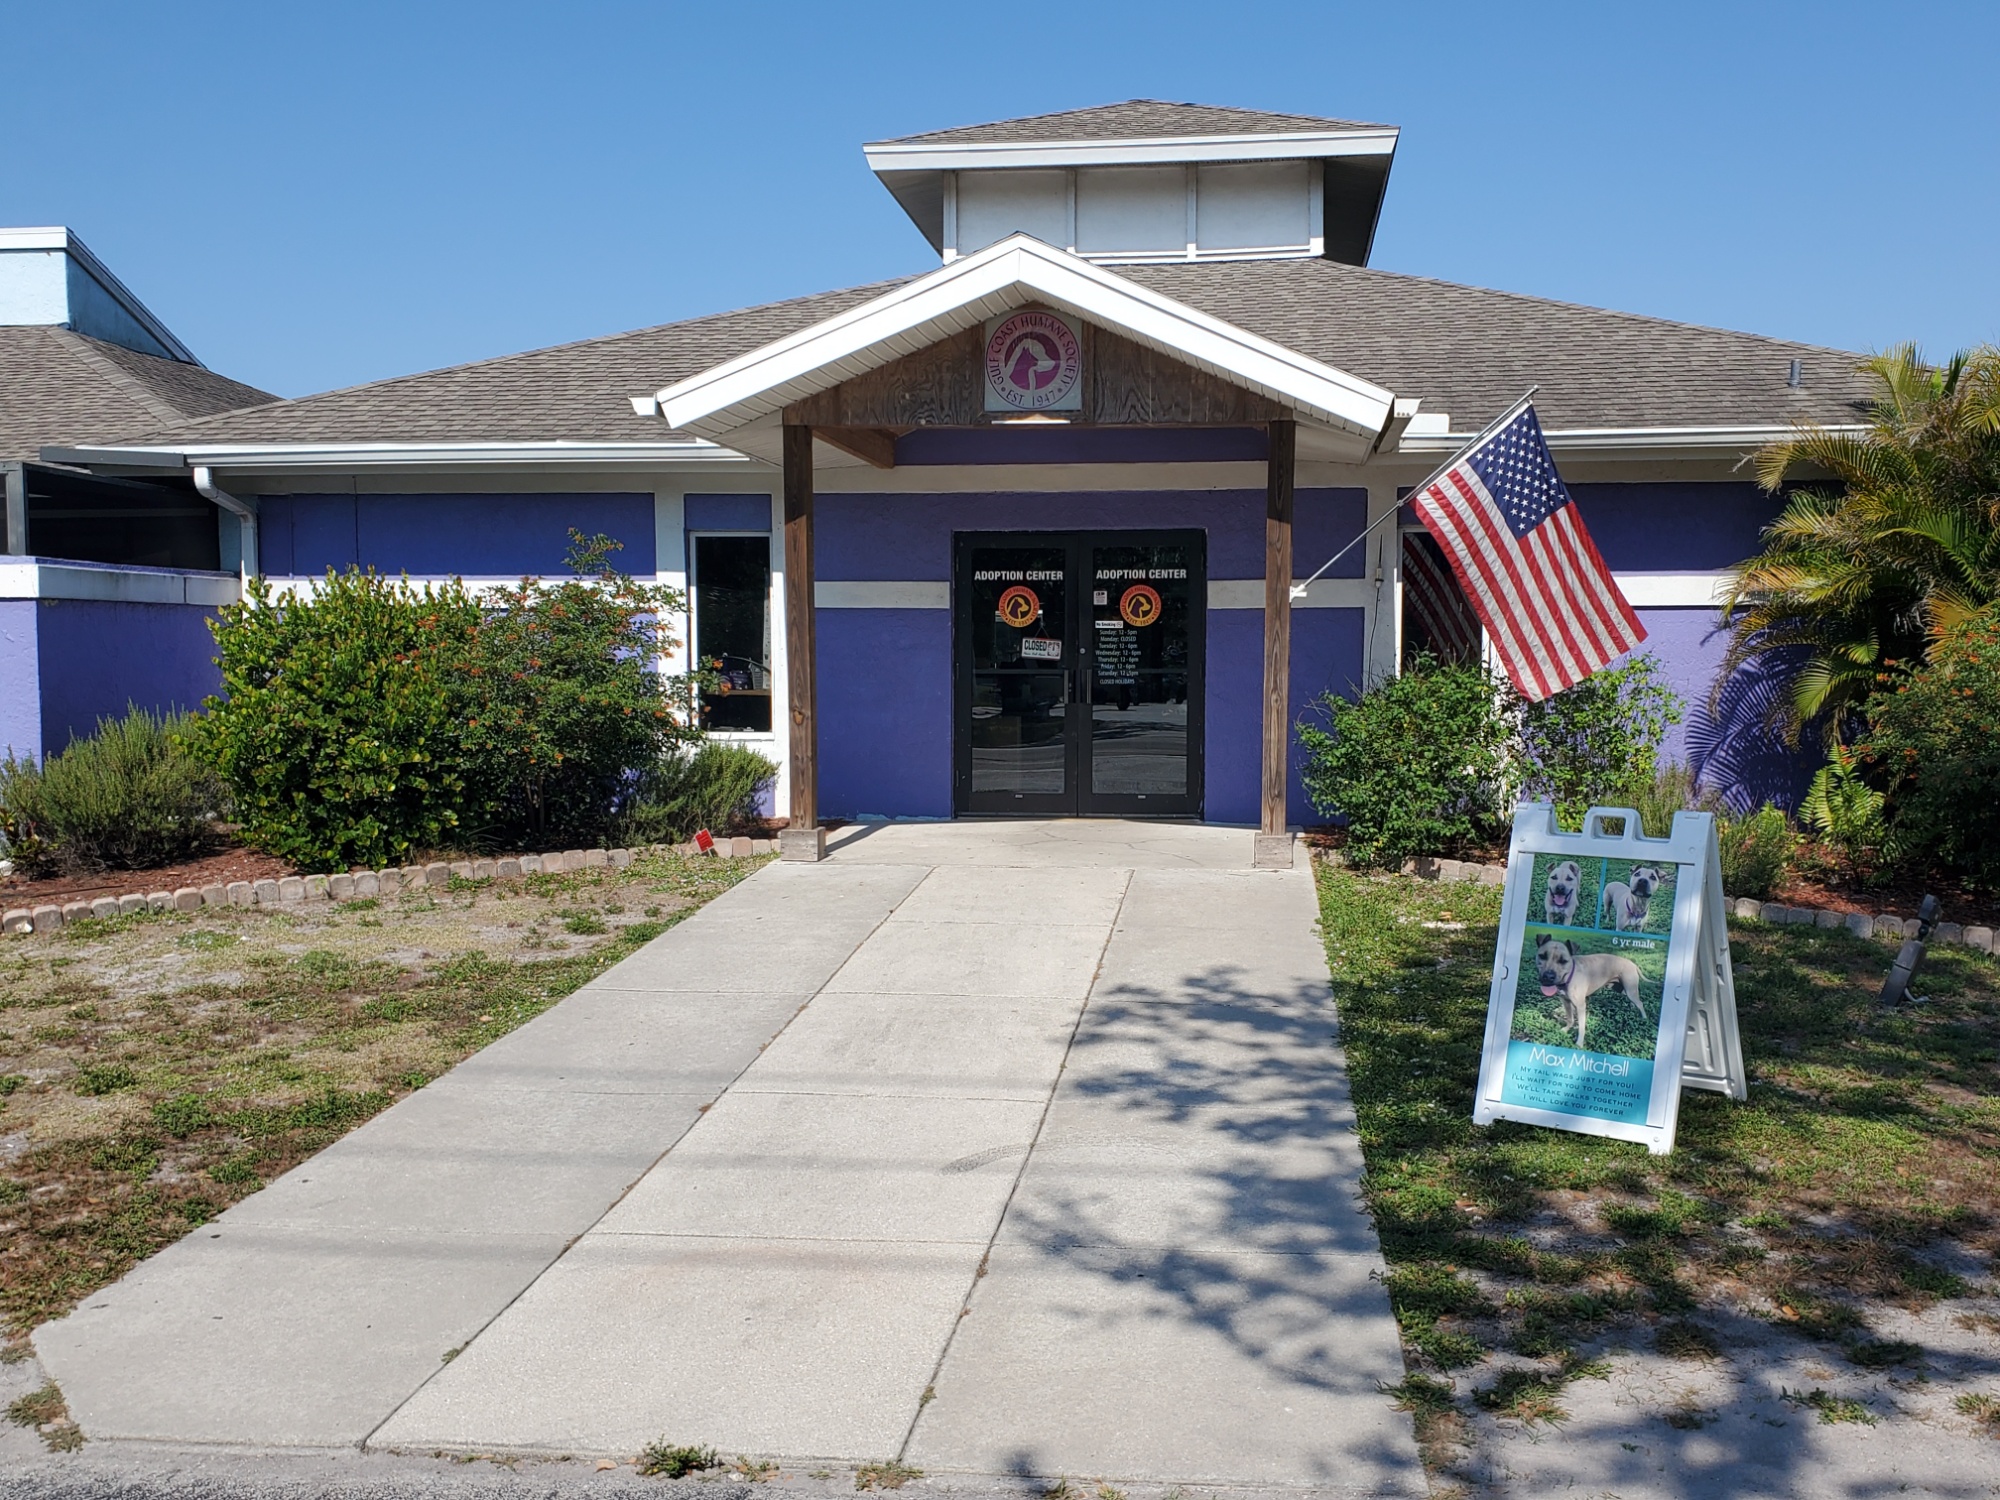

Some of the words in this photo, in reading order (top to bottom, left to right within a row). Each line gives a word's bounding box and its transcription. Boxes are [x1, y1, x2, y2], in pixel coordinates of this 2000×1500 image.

[992, 321, 1018, 353] COAST
[1020, 316, 1068, 340] HUMANE
[989, 358, 1004, 385] GULF
[1060, 340, 1077, 388] SOCIETY
[1032, 390, 1056, 406] 1947
[974, 571, 1023, 580] ADOPTION
[1026, 571, 1064, 580] CENTER
[1096, 570, 1146, 579] ADOPTION
[1149, 569, 1187, 579] CENTER
[1024, 640, 1047, 651] CLOSED
[1620, 938, 1630, 947] yr
[1632, 940, 1655, 948] male
[1529, 1046, 1565, 1068] Max
[1569, 1052, 1629, 1077] Mitchell
[1534, 1068, 1550, 1076] TAIL
[1552, 1072, 1573, 1080] WAGS
[1576, 1075, 1595, 1083] JUST
[1616, 1081, 1634, 1089] YOU!
[1517, 1083, 1540, 1092] WE'LL
[1564, 1091, 1590, 1100] WALKS
[1593, 1096, 1633, 1108] TOGETHER
[1595, 1087, 1616, 1096] COME
[1620, 1091, 1641, 1100] HOME
[1529, 1095, 1547, 1103] WILL
[1550, 1098, 1568, 1107] LOVE
[1589, 1105, 1624, 1115] FOREVER
